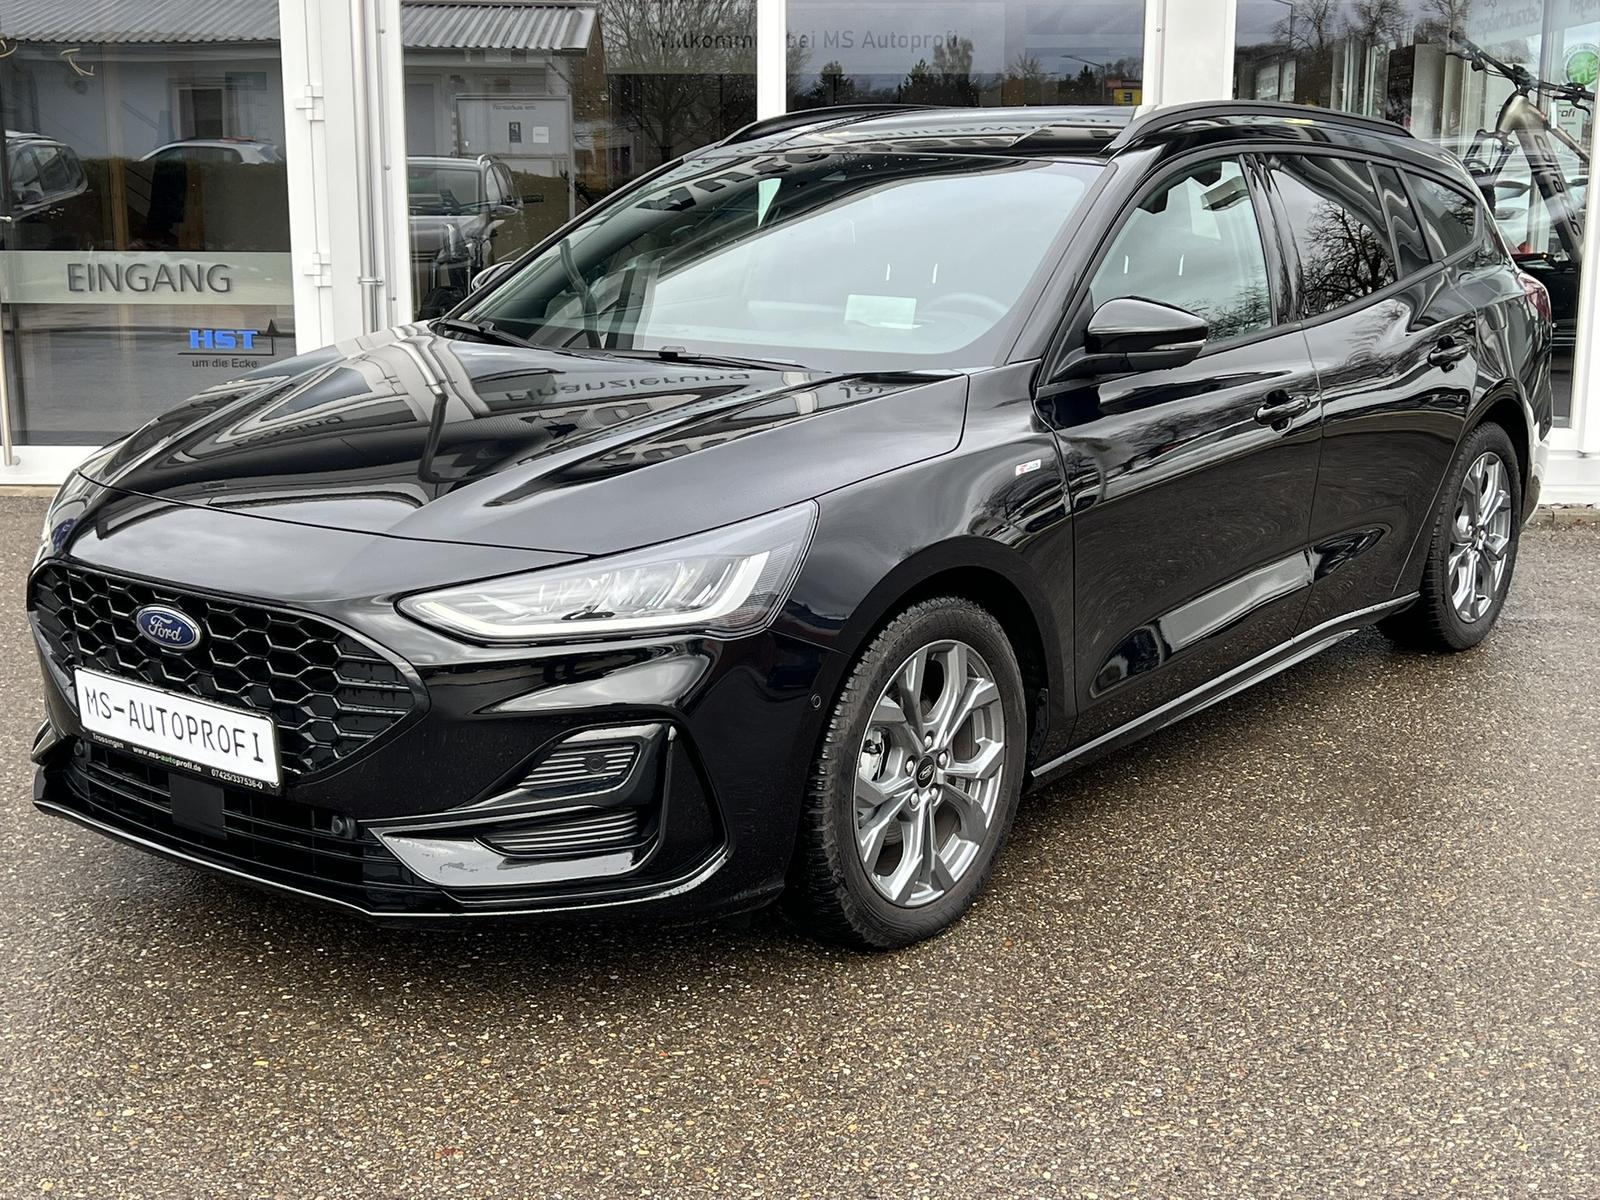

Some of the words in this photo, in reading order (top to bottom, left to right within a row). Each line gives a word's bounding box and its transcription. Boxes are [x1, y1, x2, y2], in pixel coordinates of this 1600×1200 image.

[651, 31, 758, 49] Willkomm
[786, 31, 816, 49] bei
[823, 31, 854, 49] MS
[862, 30, 958, 53] Autoprofi
[67, 263, 231, 293] EINGANG
[189, 329, 259, 349] HST
[192, 360, 209, 368] um
[212, 358, 228, 368] die
[232, 358, 257, 368] Ecke
[148, 614, 183, 642] Ford
[84, 686, 264, 763] MS-AUTOPROFI
[92, 732, 124, 749] Trossingen
[132, 746, 202, 773] www.ms-autoprofi.de
